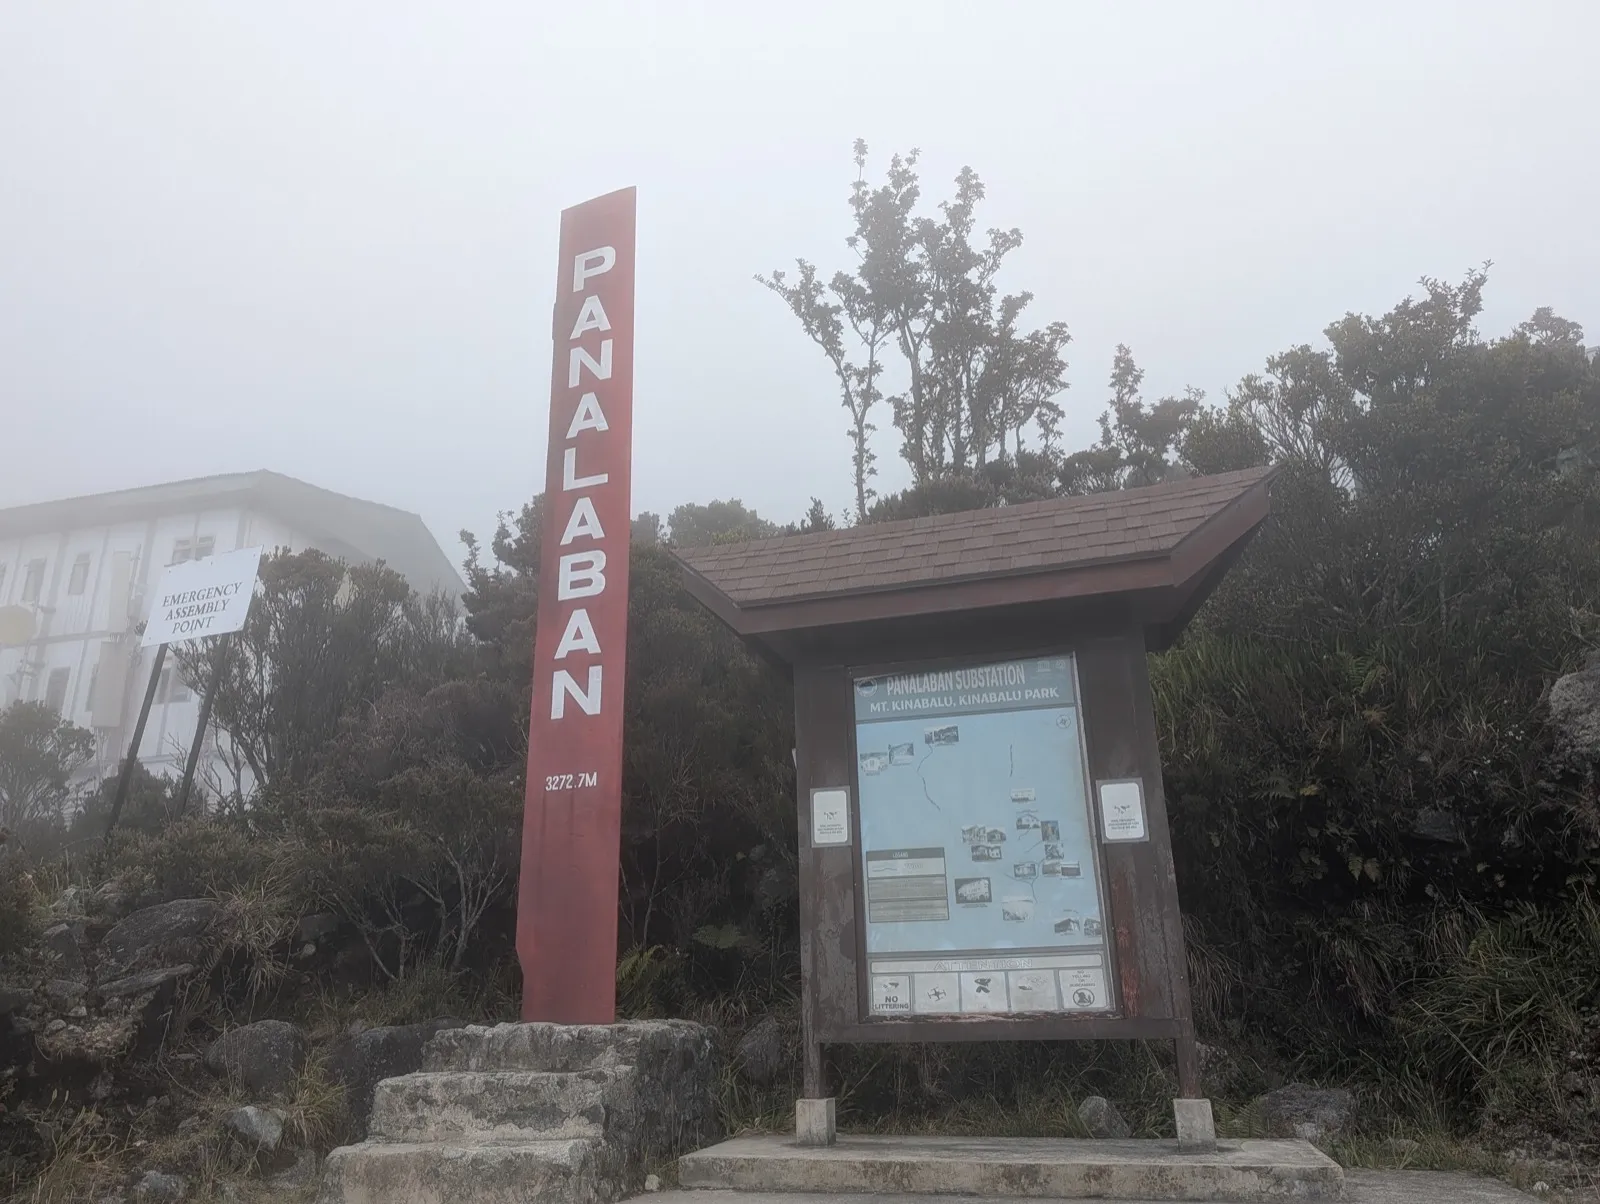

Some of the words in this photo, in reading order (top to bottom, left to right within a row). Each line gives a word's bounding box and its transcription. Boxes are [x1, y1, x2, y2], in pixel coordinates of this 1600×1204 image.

[549, 245, 617, 720] PANALABAN
[162, 582, 242, 607] EMERGENCY
[165, 599, 230, 621] ASSEMBLY
[172, 616, 215, 634] POINT
[886, 671, 953, 696] PANALABAN
[955, 663, 1026, 690] SUBSTATION
[870, 701, 890, 713] MT.
[892, 695, 957, 711] KINABALU,
[959, 690, 1021, 706] KINABALU
[1024, 686, 1060, 700] PARK
[545, 771, 598, 791] 3272.7M
[933, 958, 1033, 972] ATTENTION
